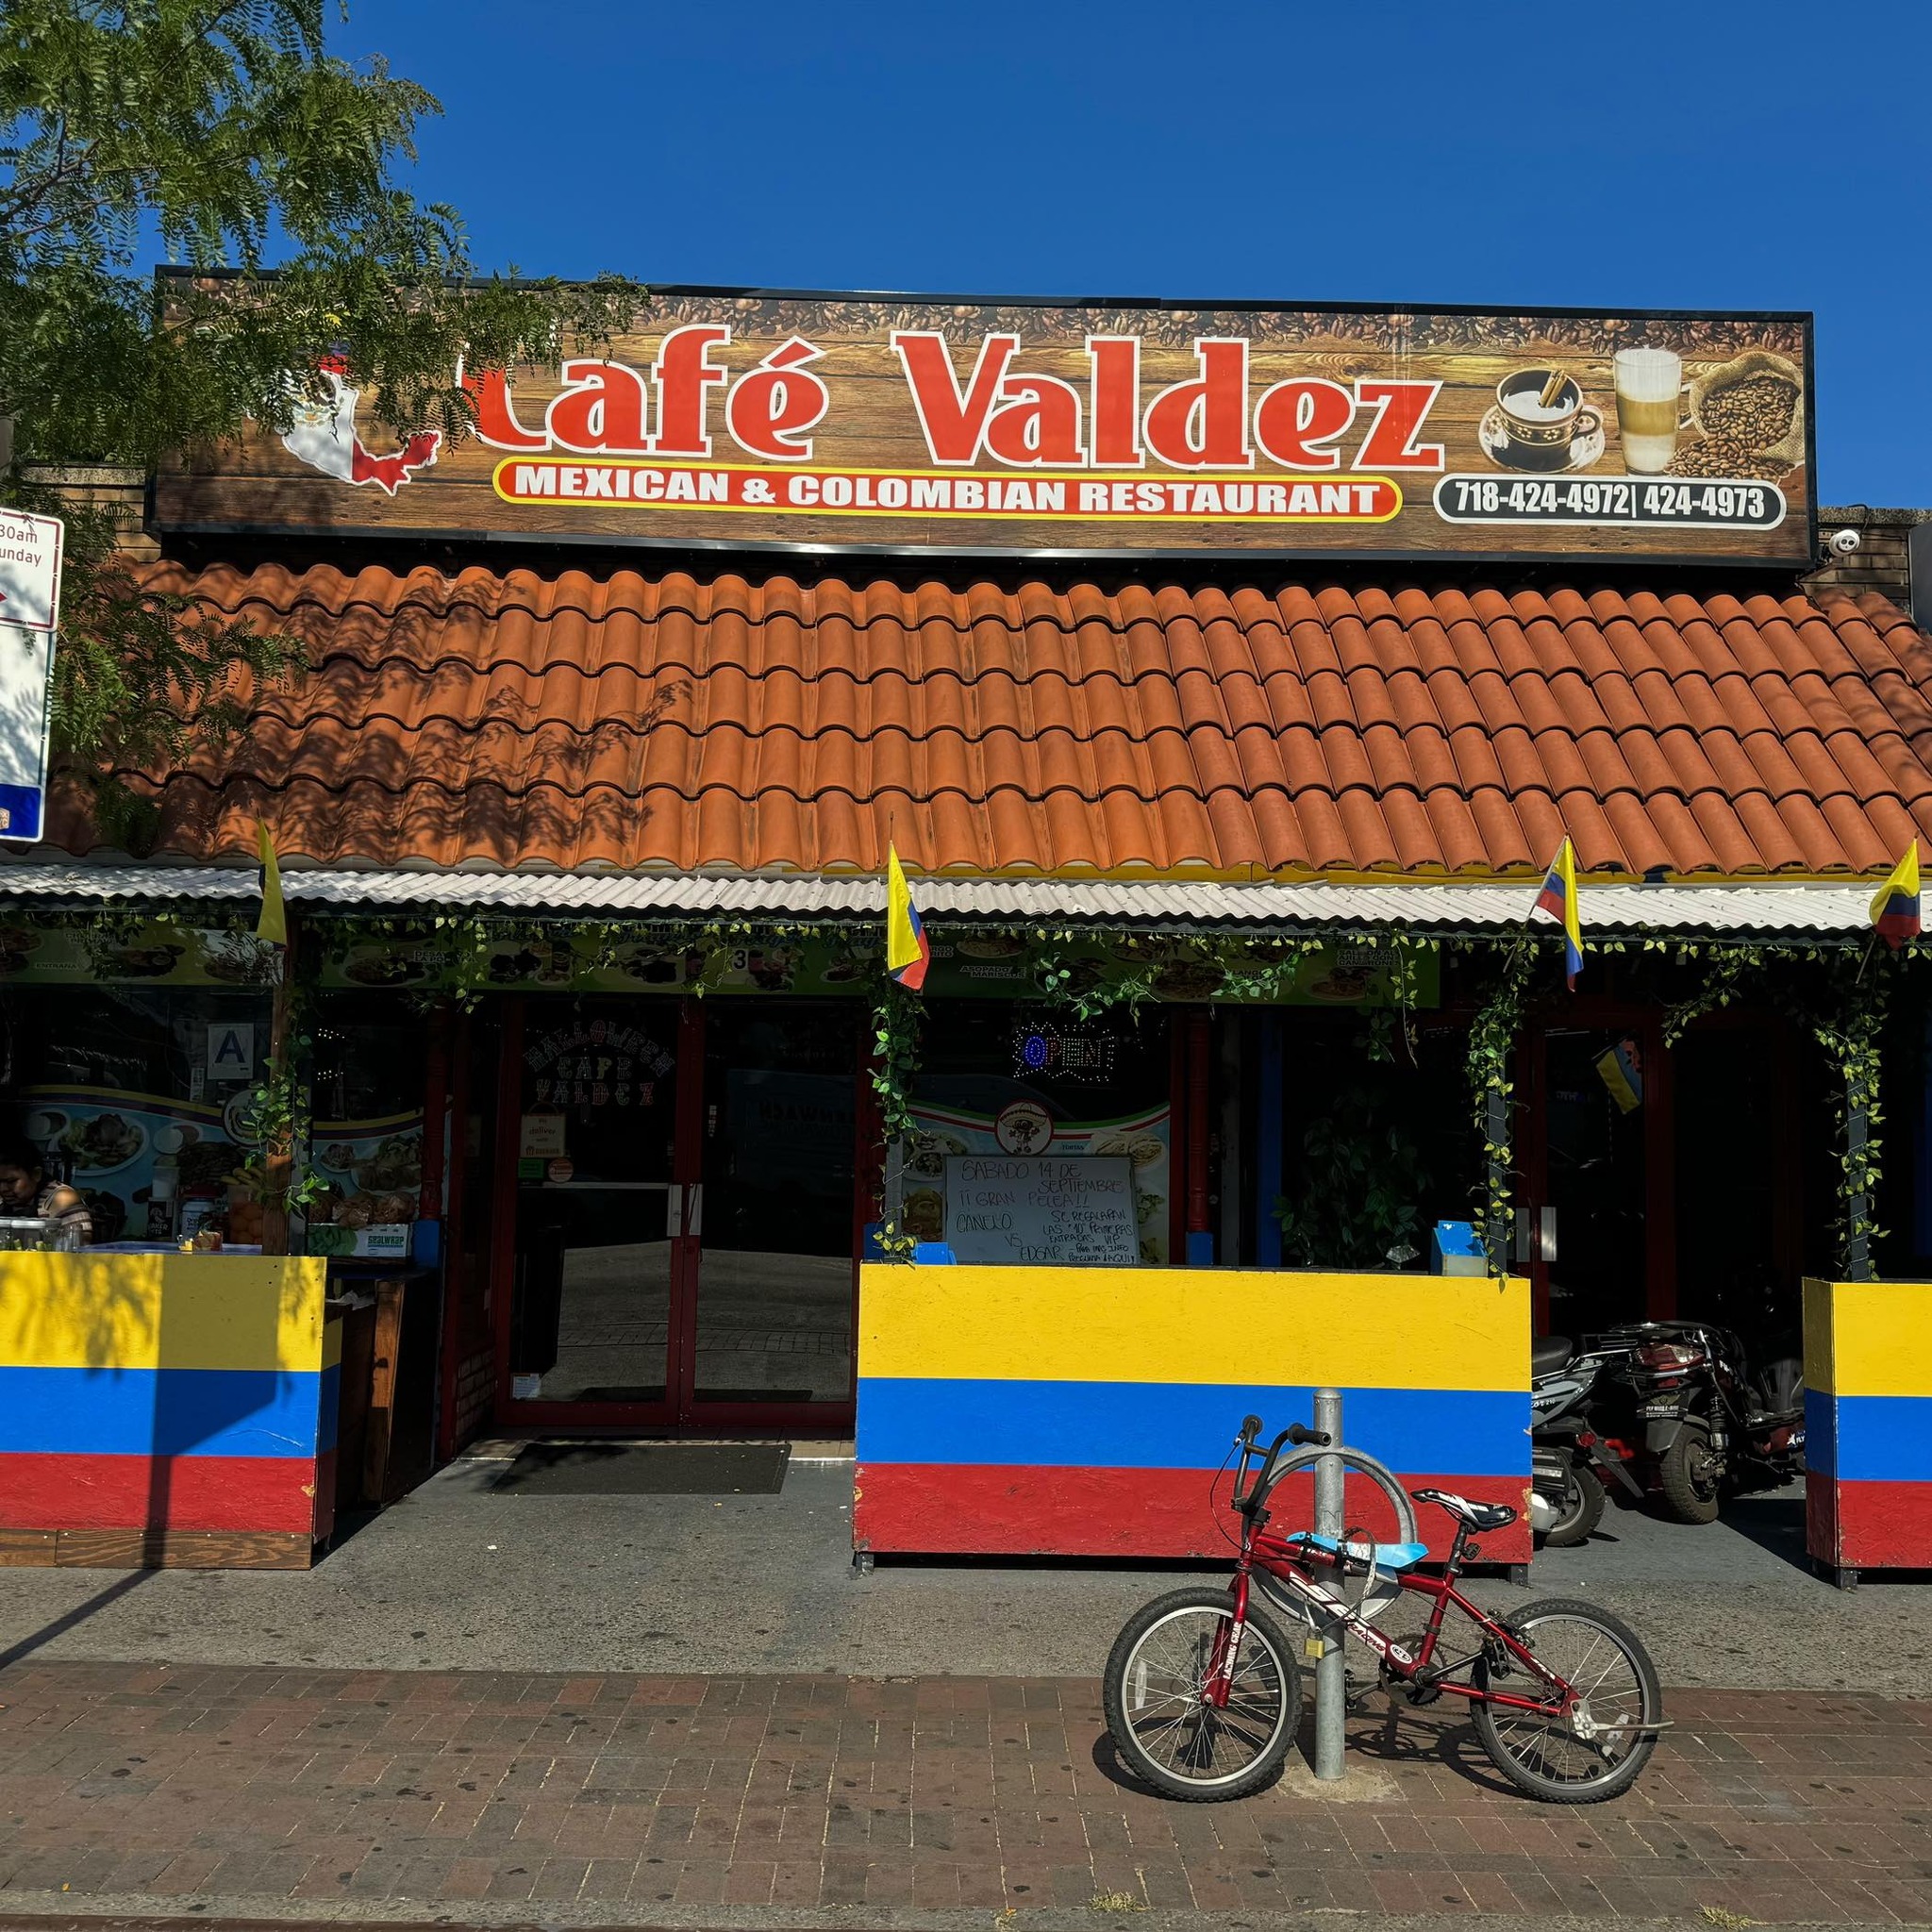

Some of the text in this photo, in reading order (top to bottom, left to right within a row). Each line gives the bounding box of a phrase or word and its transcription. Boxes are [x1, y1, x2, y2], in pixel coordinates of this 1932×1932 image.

[891, 330, 1445, 471] Valdez
[514, 465, 1381, 514] MEXICAN & COLOMBIAN RESTAURANT
[1644, 486, 1764, 518] 424-4973
[214, 1030, 245, 1063] A
[1024, 1036, 1102, 1068] OPEN
[535, 1078, 656, 1107] VALDEZ
[962, 1159, 1083, 1181] SABADO 14 DE
[975, 1191, 1015, 1207] GRAN
[1038, 1177, 1124, 1193] SEPTIEMBRE
[956, 1212, 1012, 1233] CANELO
[1043, 1224, 1063, 1236] LAS
[1020, 1245, 1064, 1261] EDGAR
[1104, 1235, 1121, 1245] VIP
[1223, 1621, 1243, 1679] LANDING GEAR
[1346, 1623, 1386, 1652] RACING
